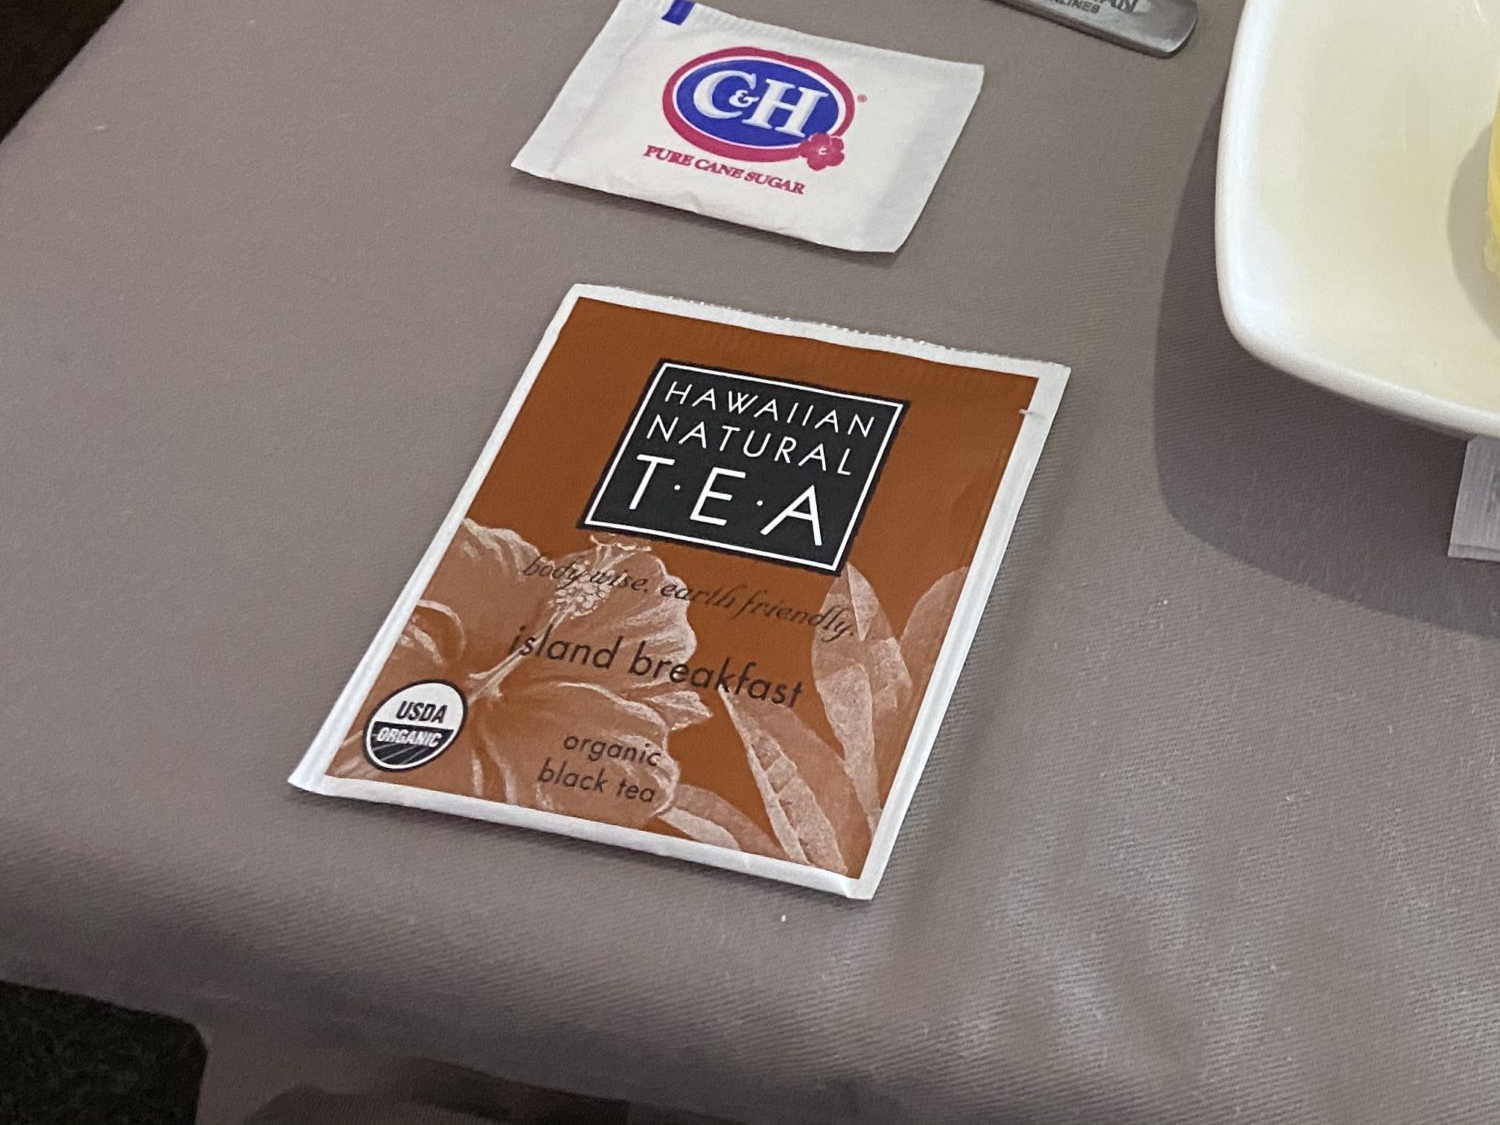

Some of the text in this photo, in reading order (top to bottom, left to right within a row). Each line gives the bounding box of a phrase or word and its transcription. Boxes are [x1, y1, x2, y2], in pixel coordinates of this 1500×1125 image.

[693, 70, 828, 137] C&H
[643, 145, 806, 195] PURE CANE SUGAR
[664, 381, 874, 438] HAWAIIAN
[646, 414, 852, 475] NATURAL
[523, 555, 856, 643] body wise. earth friendly.
[508, 625, 804, 708] island breakfast
[376, 727, 443, 748] ORGANIC
[396, 700, 448, 724] USDA
[564, 734, 661, 767] organic
[537, 758, 655, 803] black tea
